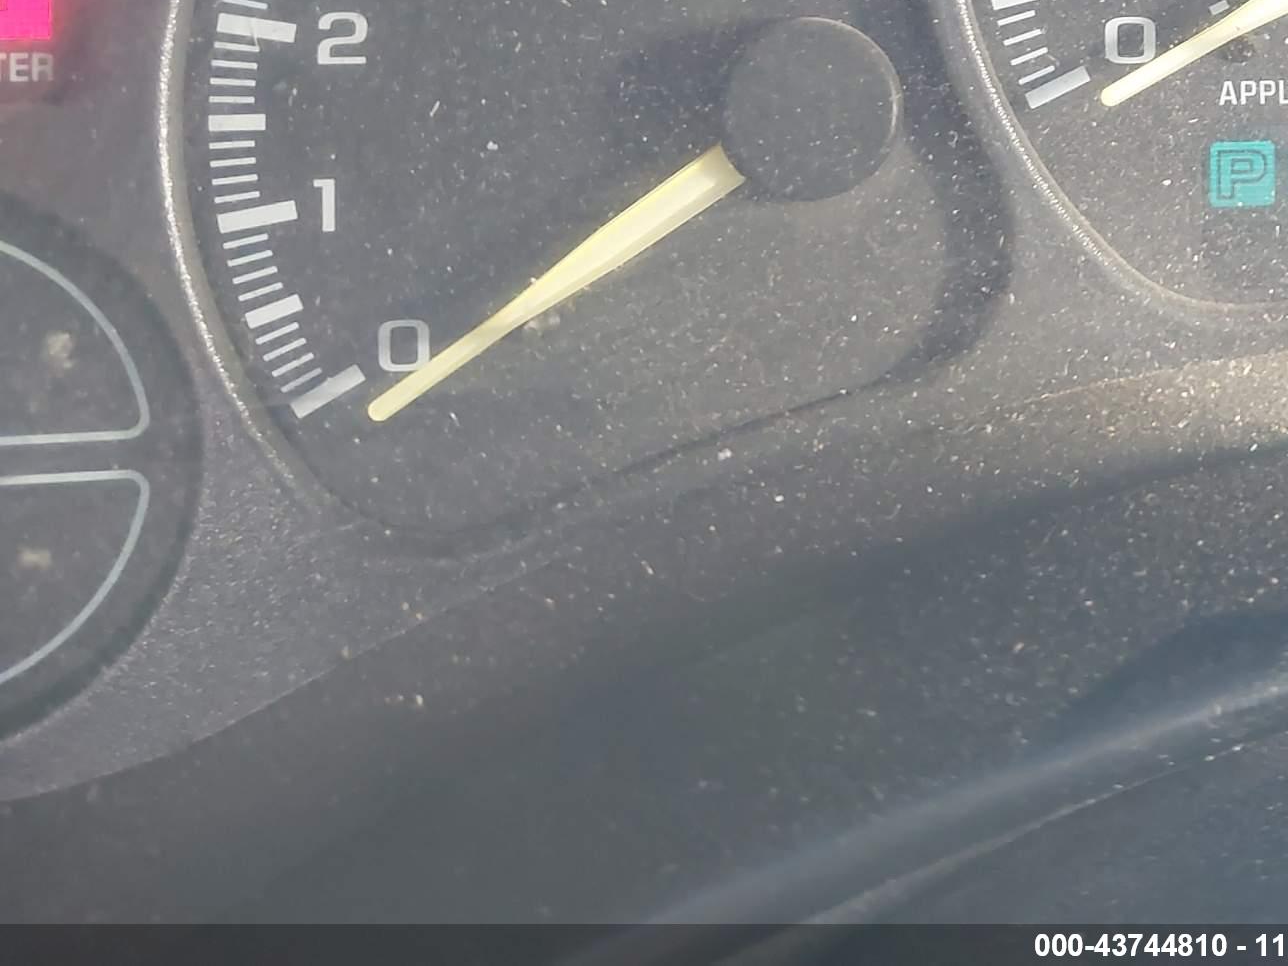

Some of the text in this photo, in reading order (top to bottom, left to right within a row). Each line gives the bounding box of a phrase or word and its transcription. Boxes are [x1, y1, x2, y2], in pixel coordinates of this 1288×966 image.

[316, 11, 368, 65] 2
[1104, 16, 1156, 64] 0
[1214, 147, 1269, 201] P
[313, 178, 337, 233] 1
[377, 319, 430, 371] 0
